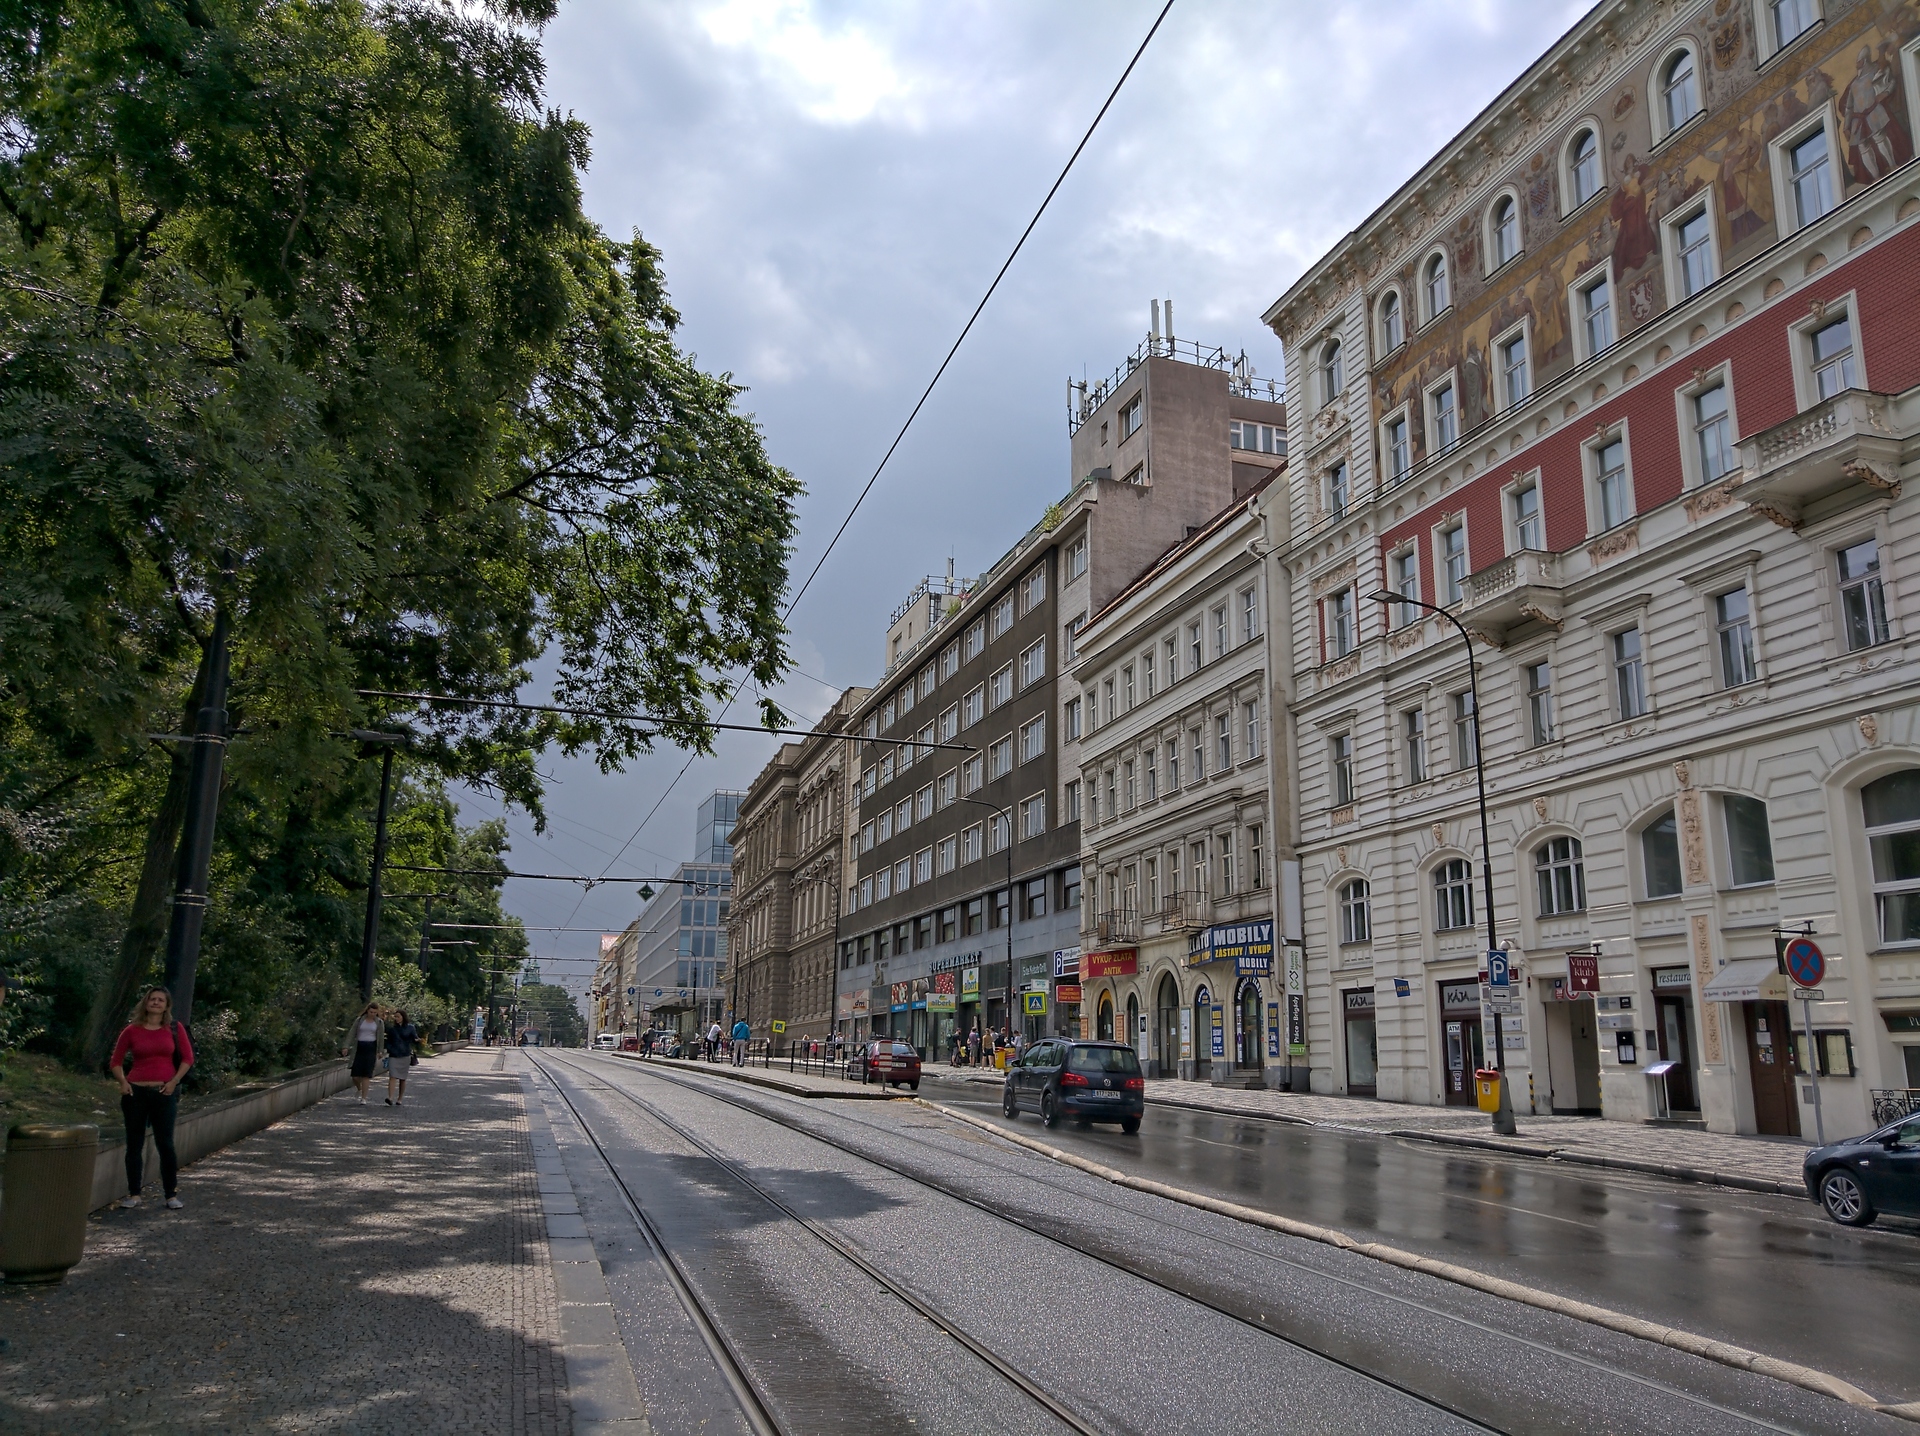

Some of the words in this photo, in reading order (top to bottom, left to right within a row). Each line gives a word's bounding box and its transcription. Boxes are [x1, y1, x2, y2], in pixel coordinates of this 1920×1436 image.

[1214, 925, 1270, 946] MOBILY
[1215, 946, 1243, 958] ZÁSTAVY
[1248, 944, 1272, 955] VÝKUP
[929, 951, 980, 971] SUPERMARKET
[1092, 954, 1112, 964] VÝKUP
[1113, 952, 1133, 962] ZLATA
[1239, 958, 1268, 968] MOBILY
[1570, 957, 1596, 968] Vinný
[1103, 966, 1122, 976] ANTIK
[1492, 960, 1505, 982] P
[1574, 967, 1595, 977] klub
[1349, 995, 1368, 1007] KÁJA
[1447, 988, 1470, 1004] KÁJA
[931, 999, 952, 1007] albert
